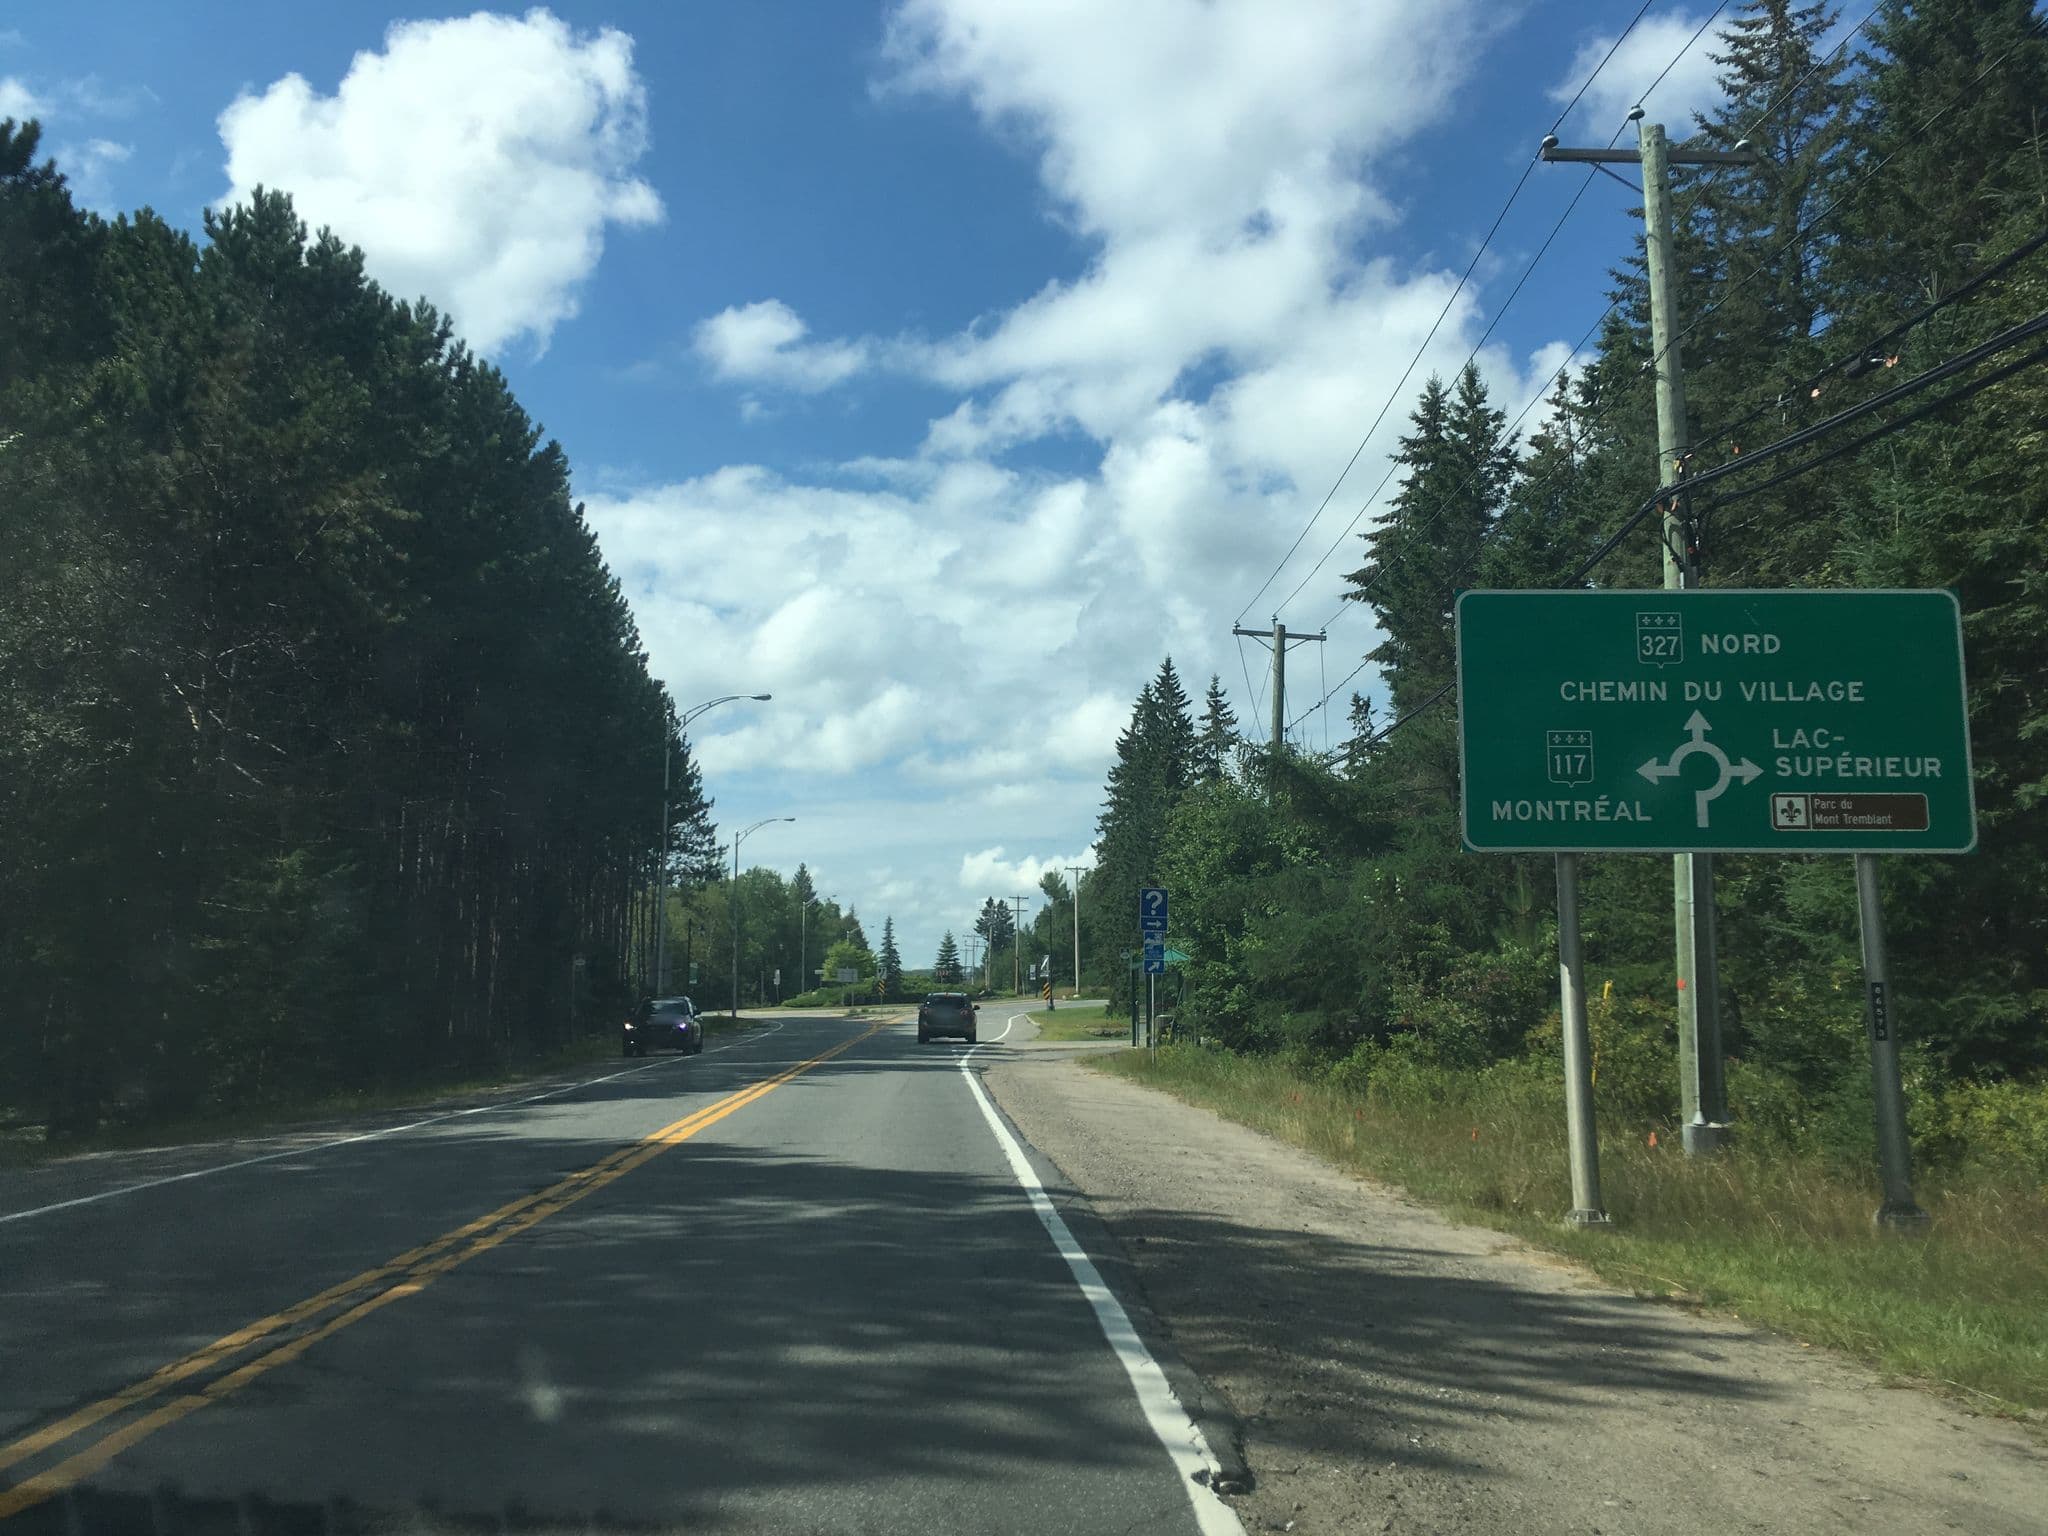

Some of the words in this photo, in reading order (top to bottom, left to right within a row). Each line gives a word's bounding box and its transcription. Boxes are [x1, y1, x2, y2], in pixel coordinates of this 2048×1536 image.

[1641, 635, 1679, 657] 327
[1701, 633, 1781, 654] NORD
[1560, 680, 1667, 702] CHEMIN
[1684, 680, 1722, 702] DU
[1739, 680, 1865, 702] VILLAGE
[1773, 728, 1845, 749] LAC-
[1554, 753, 1586, 775] 117
[1775, 751, 1942, 778] SUPÉRIEUR
[1492, 794, 1653, 822] MONTRÉAL
[1813, 798, 1837, 810] Parc
[1840, 798, 1853, 810] du
[1814, 813, 1840, 825] Mont
[1842, 813, 1893, 825] Tremblant
